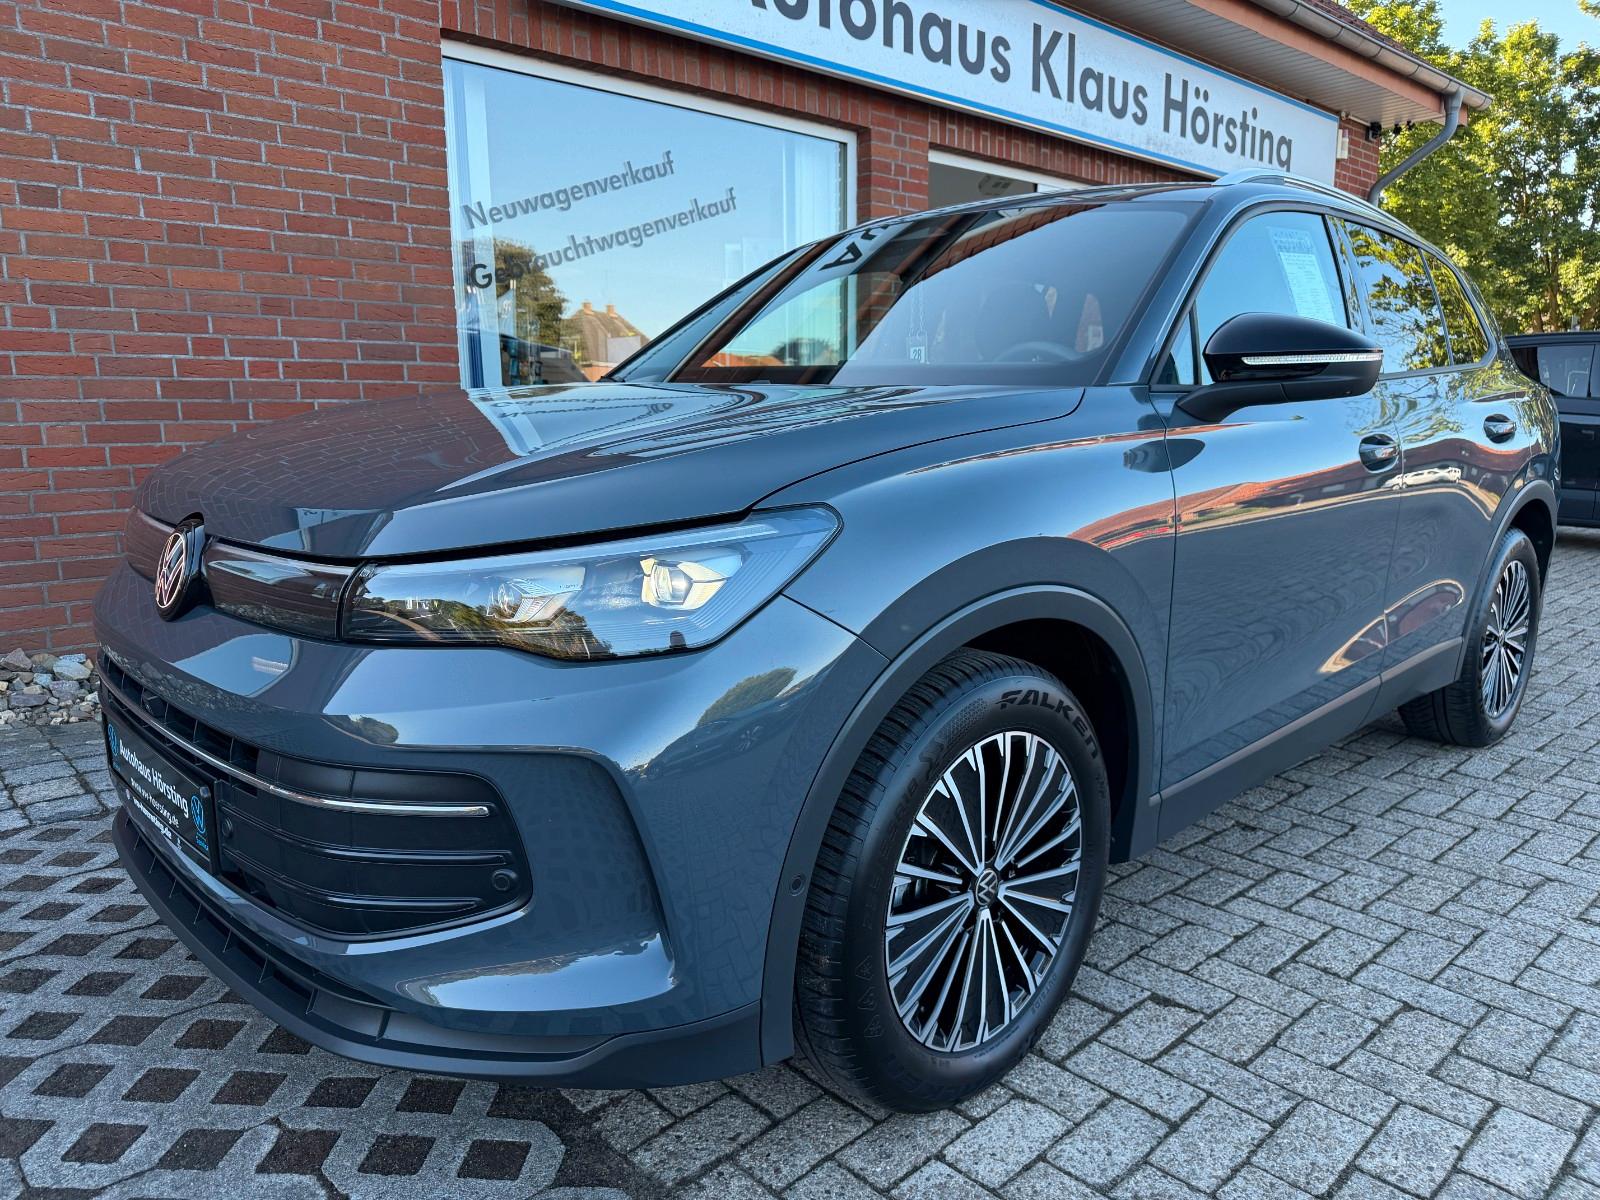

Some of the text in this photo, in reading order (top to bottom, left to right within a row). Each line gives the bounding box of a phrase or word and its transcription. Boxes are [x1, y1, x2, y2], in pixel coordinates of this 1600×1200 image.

[1032, 23, 1148, 126] Klaus
[1163, 72, 1293, 172] Hörsting
[462, 149, 674, 229] Neuwagenverkauf
[470, 186, 737, 289] Gebrauchtwagenverkauf
[995, 689, 1098, 759] FALKEN
[119, 739, 152, 784] Autohaus
[152, 768, 189, 819] Hörsting
